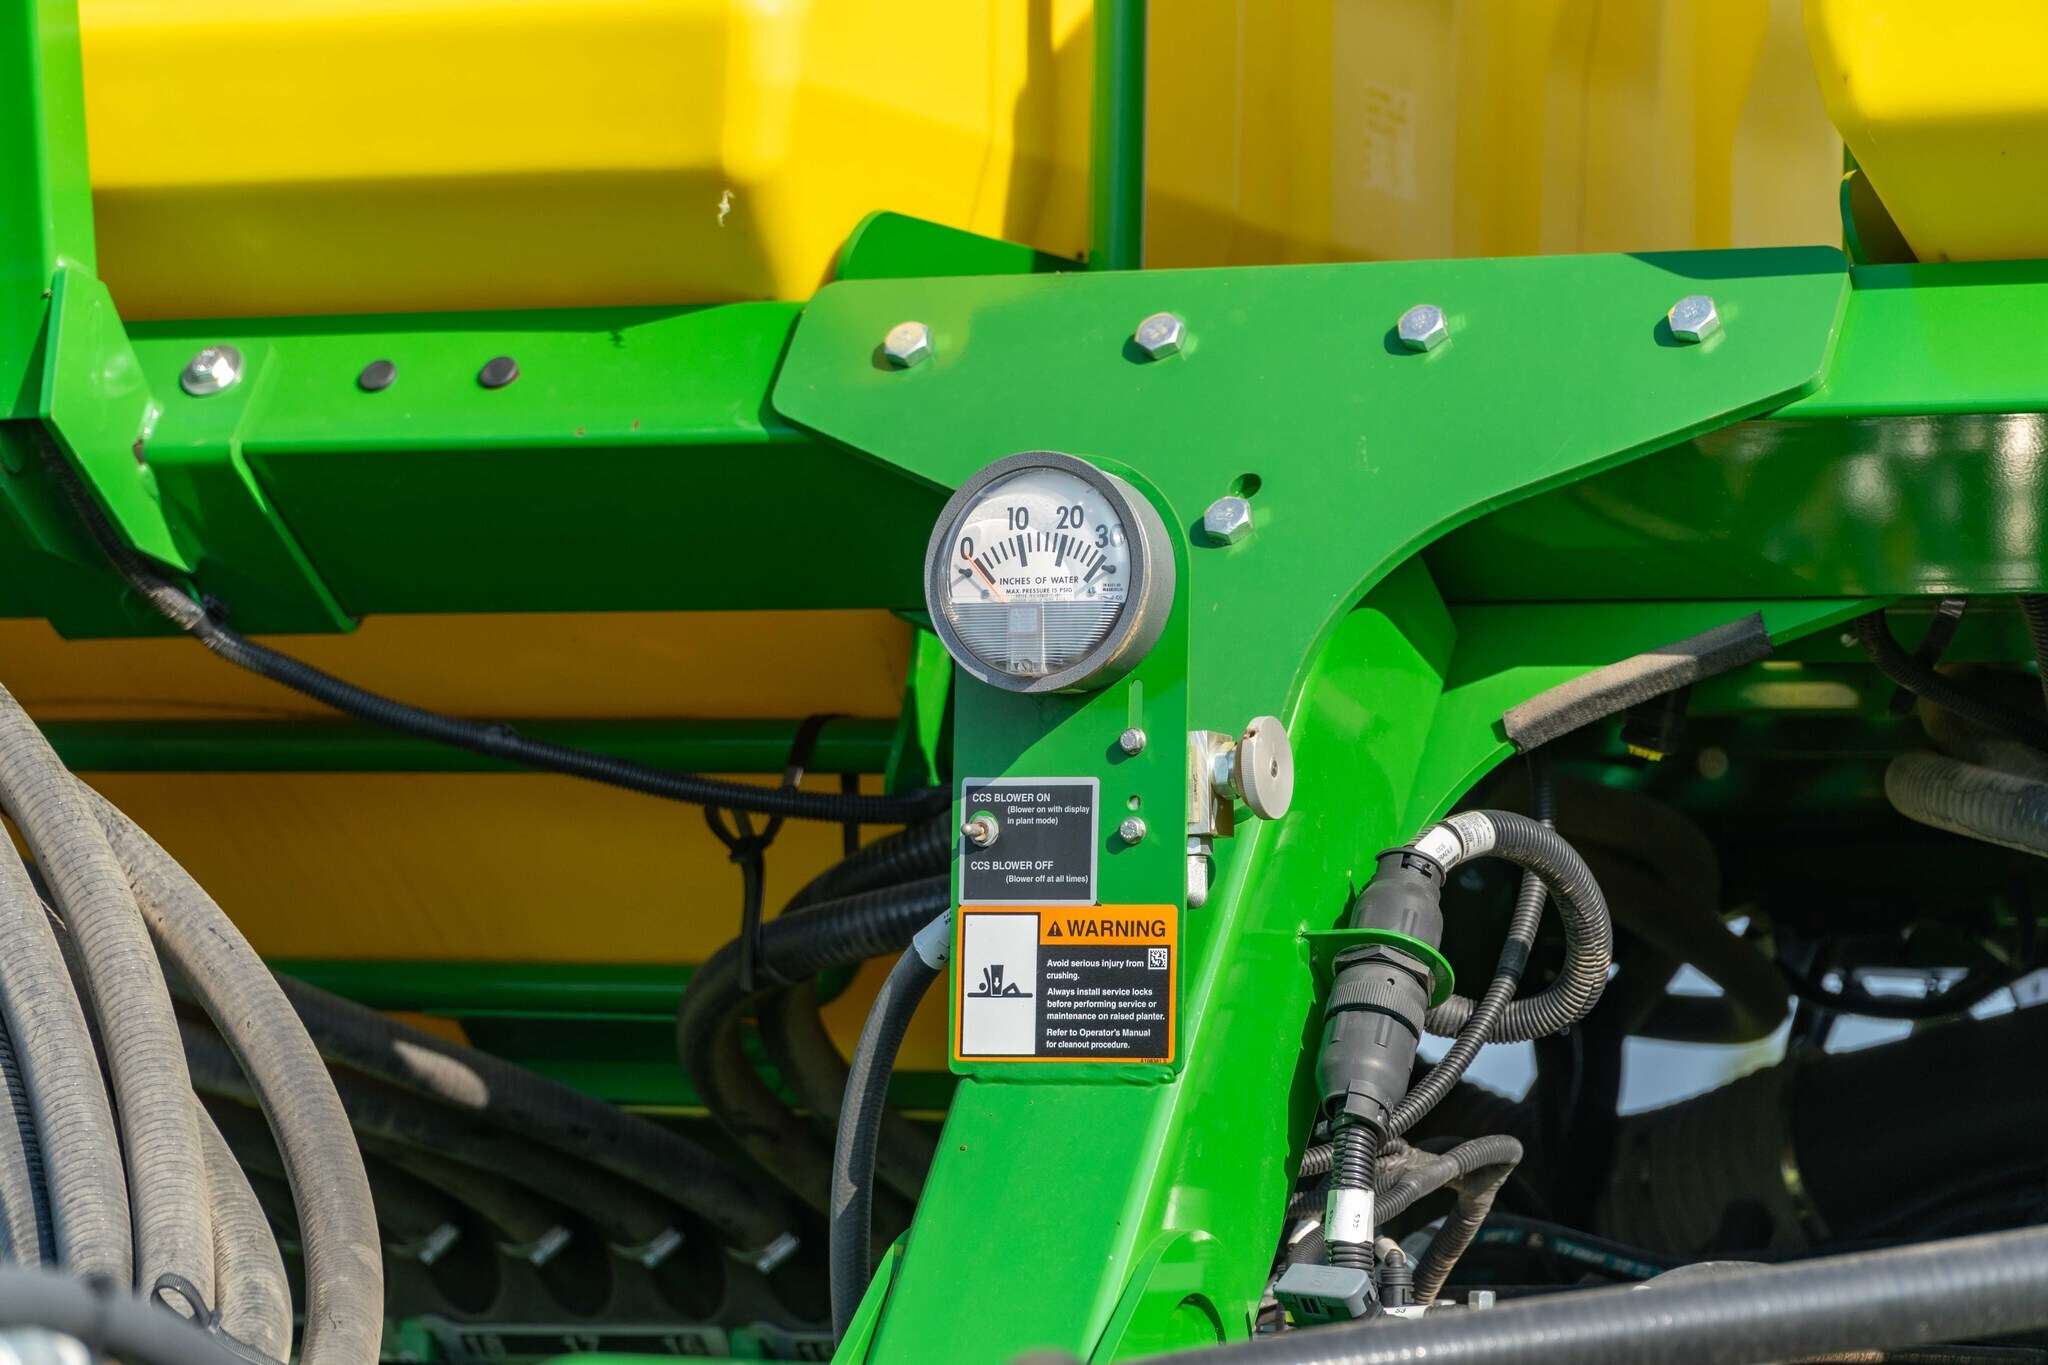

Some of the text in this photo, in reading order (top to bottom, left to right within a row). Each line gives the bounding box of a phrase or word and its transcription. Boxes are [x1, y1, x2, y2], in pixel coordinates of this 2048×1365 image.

[1006, 506, 1030, 530] 10
[1056, 505, 1084, 529] 20
[1094, 524, 1125, 548] 30
[960, 536, 974, 560] 0
[999, 577, 1030, 585] INCHES
[1050, 576, 1079, 584] WATER
[972, 793, 1050, 802] CCS BLOWER ON
[1007, 806, 1034, 814] (Blower
[1064, 806, 1090, 814] display
[1016, 817, 1034, 825] plant
[1036, 817, 1058, 825] mode)
[1436, 842, 1446, 853] CCS
[971, 861, 1054, 870] CCS BLOWER OFF
[1006, 875, 1033, 883] (Blower
[1066, 875, 1088, 884] times)
[1067, 920, 1166, 937] WARNING
[1047, 959, 1069, 967] Avoid
[1101, 959, 1124, 969] injury
[1126, 959, 1144, 967] from
[1046, 972, 1080, 981] crushing.
[1047, 988, 1075, 997] Always
[1077, 988, 1100, 996] install
[1074, 1000, 1116, 1009] performing
[1110, 1012, 1134, 1020] raised
[1136, 1012, 1165, 1022] planter.
[1079, 1029, 1120, 1038] Operator's
[1091, 1041, 1130, 1050] procedure.
[1352, 1214, 1360, 1228] CCS
